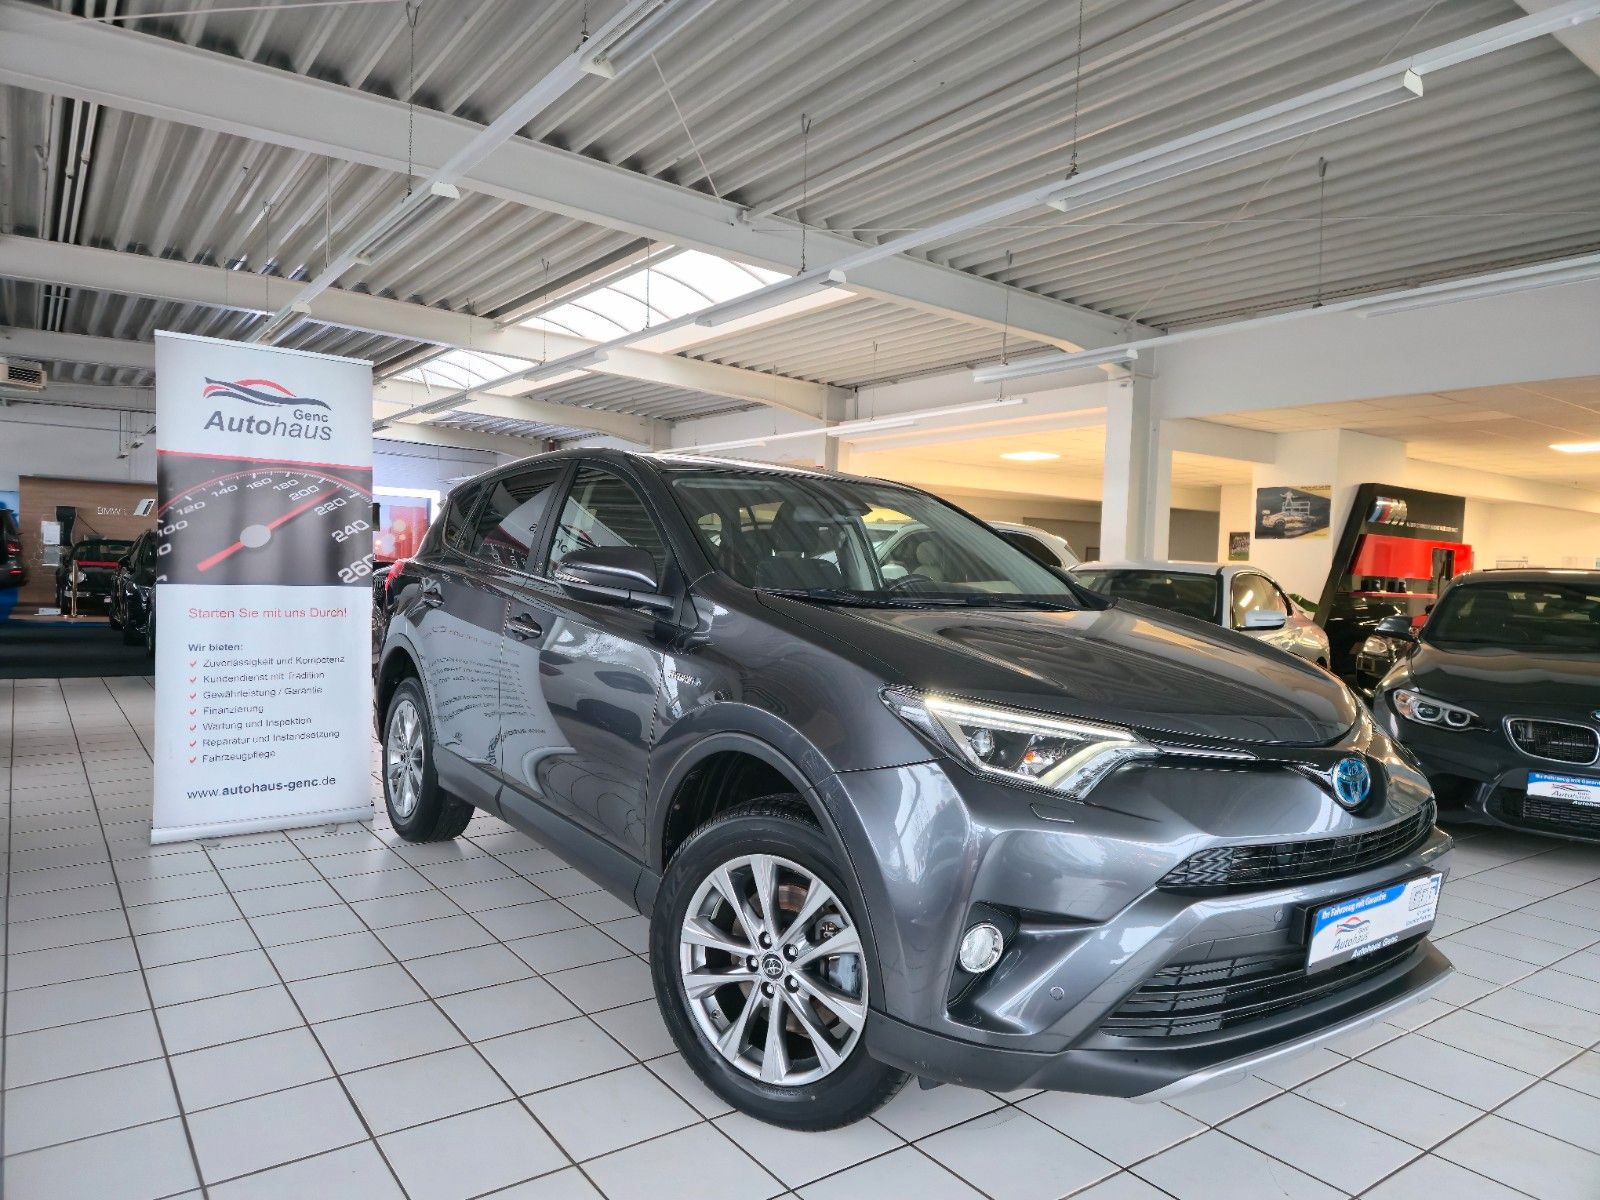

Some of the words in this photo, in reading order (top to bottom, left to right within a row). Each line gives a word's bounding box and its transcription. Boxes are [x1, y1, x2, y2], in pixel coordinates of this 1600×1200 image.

[293, 409, 329, 423] Genc
[203, 410, 333, 441] Autohaus
[246, 477, 273, 490] 160
[273, 479, 299, 492] 180
[210, 484, 238, 498] 140
[288, 484, 320, 501] 200
[176, 500, 206, 516] 120
[314, 497, 347, 516] 220
[331, 519, 370, 543] 240
[188, 608, 235, 619] Starten
[239, 607, 259, 618] Sie
[263, 608, 282, 618] mit
[285, 608, 306, 618] uns
[310, 607, 347, 618] Durch!
[188, 643, 206, 652] Wir
[209, 643, 243, 652] bieten:
[276, 656, 293, 665] und
[203, 674, 268, 684] Kundendienst
[270, 674, 285, 682] mit
[288, 671, 325, 681] Tradition
[284, 686, 323, 695] Garantie
[203, 705, 264, 716] Finanzierung
[202, 723, 243, 732] Wartung
[245, 720, 262, 728] und
[266, 716, 312, 727] Inspektion
[202, 737, 250, 748] Reparatur
[252, 734, 270, 743] und
[187, 776, 336, 799] www.autohaus-genc.de
